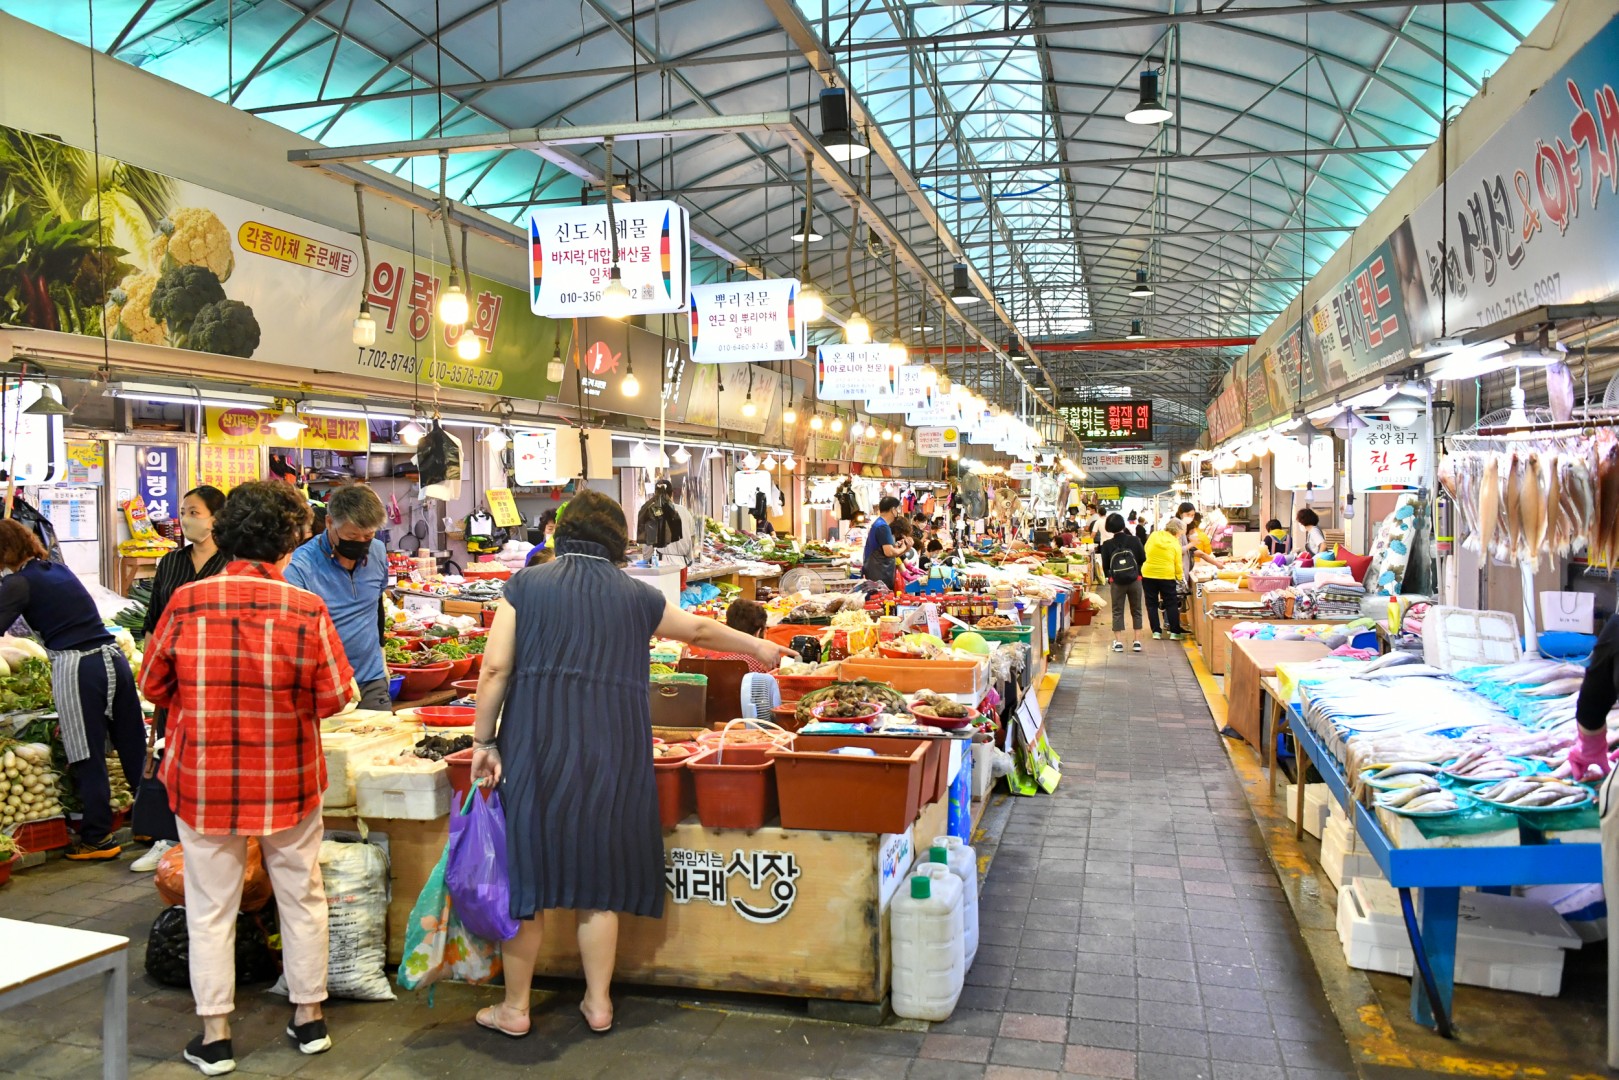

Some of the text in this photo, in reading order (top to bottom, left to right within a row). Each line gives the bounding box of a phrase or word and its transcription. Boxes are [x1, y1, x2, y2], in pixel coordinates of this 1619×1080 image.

[246, 226, 352, 274] 각종야채 주문배달
[366, 261, 502, 353] 의령회
[714, 291, 770, 309] 뿌리전문
[1331, 256, 1400, 361] 리치랜드
[709, 314, 727, 327] 연근
[729, 313, 738, 324] 외
[826, 365, 863, 373] (아로니아
[1108, 405, 1133, 419] 화재
[1136, 405, 1149, 419] 예
[1108, 419, 1133, 431] 행복
[1136, 419, 1149, 430] 미
[1366, 432, 1419, 446] 중앙침구
[672, 850, 723, 868] 책임지는
